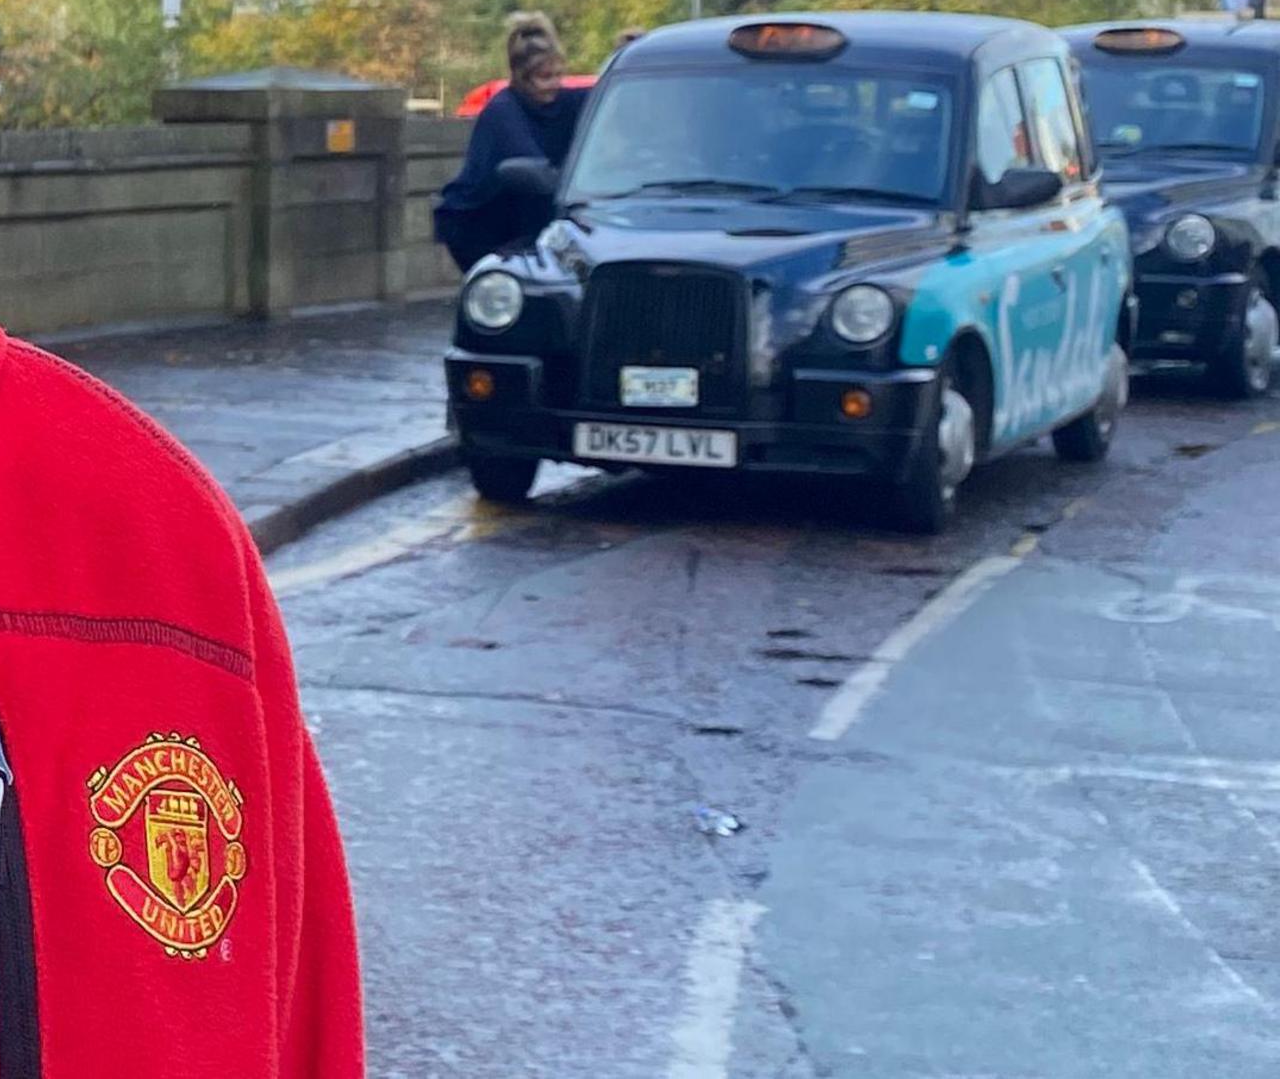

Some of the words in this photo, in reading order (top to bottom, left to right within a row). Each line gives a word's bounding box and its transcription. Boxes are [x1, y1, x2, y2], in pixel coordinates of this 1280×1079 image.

[588, 425, 658, 456] DK57
[666, 433, 724, 460] LVL
[102, 749, 236, 821] MANCHESTER
[142, 896, 225, 940] UNITED
